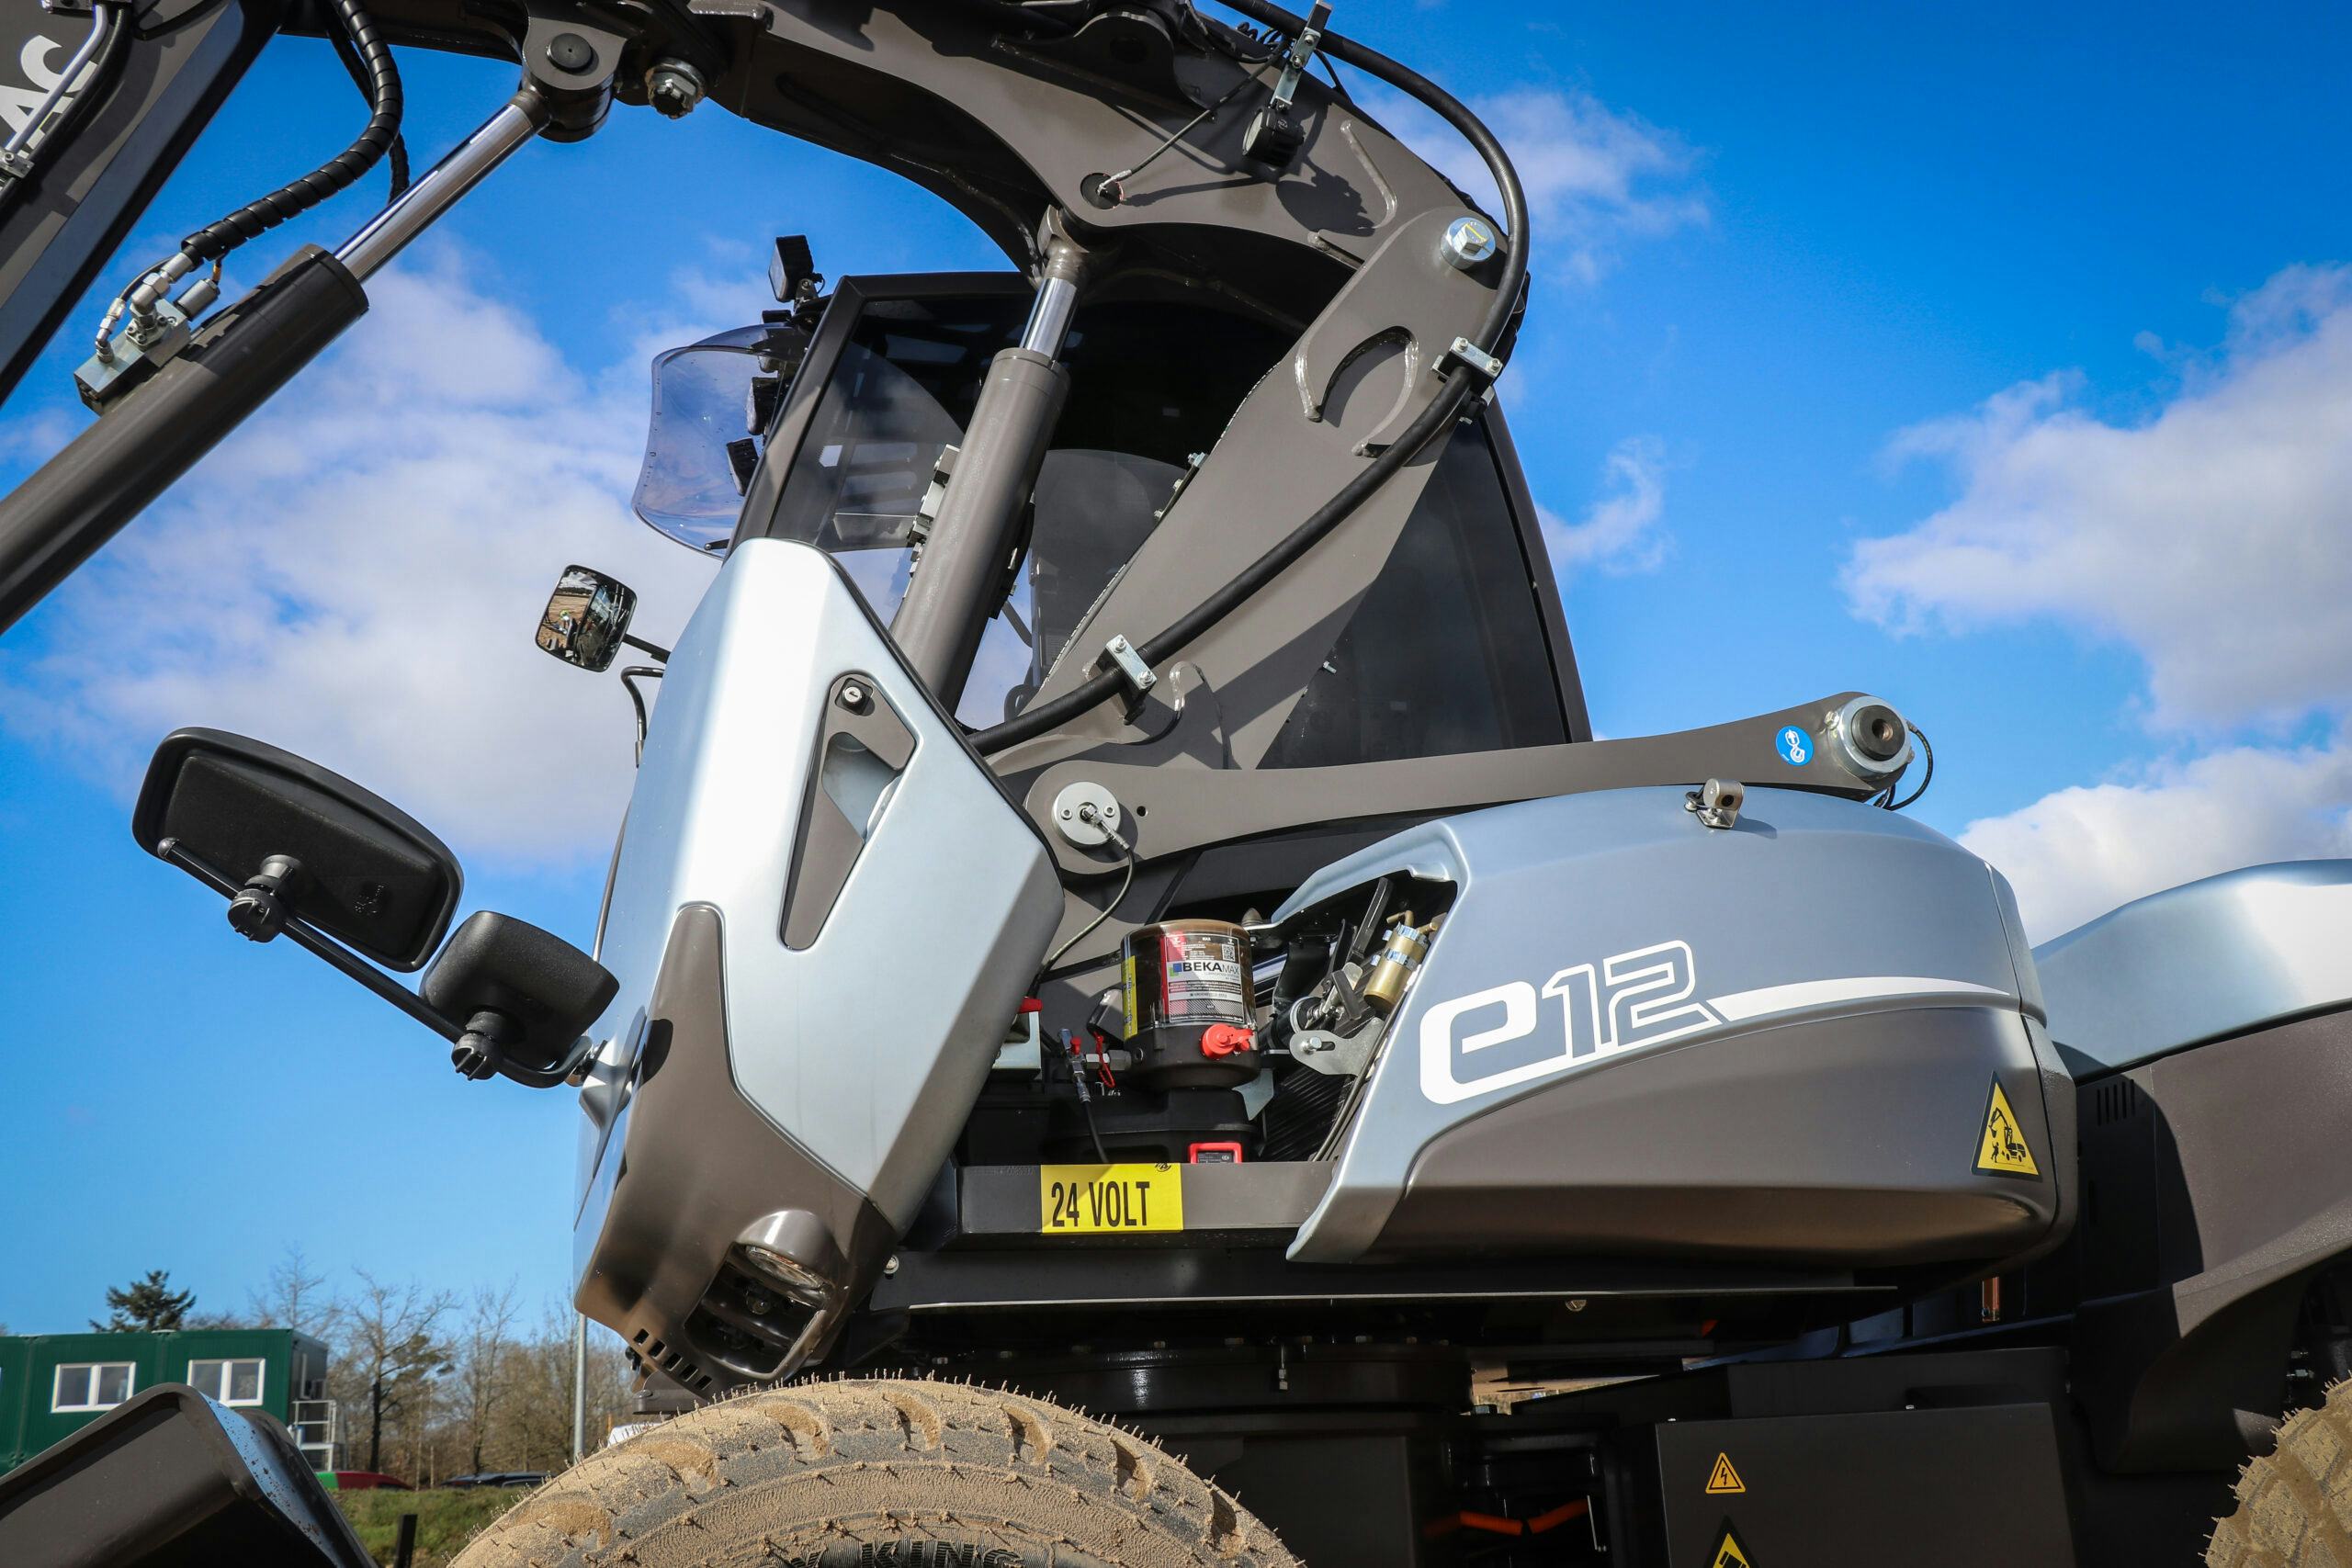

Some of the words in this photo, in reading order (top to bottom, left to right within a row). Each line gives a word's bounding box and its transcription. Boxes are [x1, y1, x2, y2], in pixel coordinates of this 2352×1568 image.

[1182, 962, 1239, 974] BEKAMAX
[1419, 939, 1724, 1105] e12
[1051, 1181, 1080, 1227] 24
[1088, 1180, 1150, 1227] VOLT
